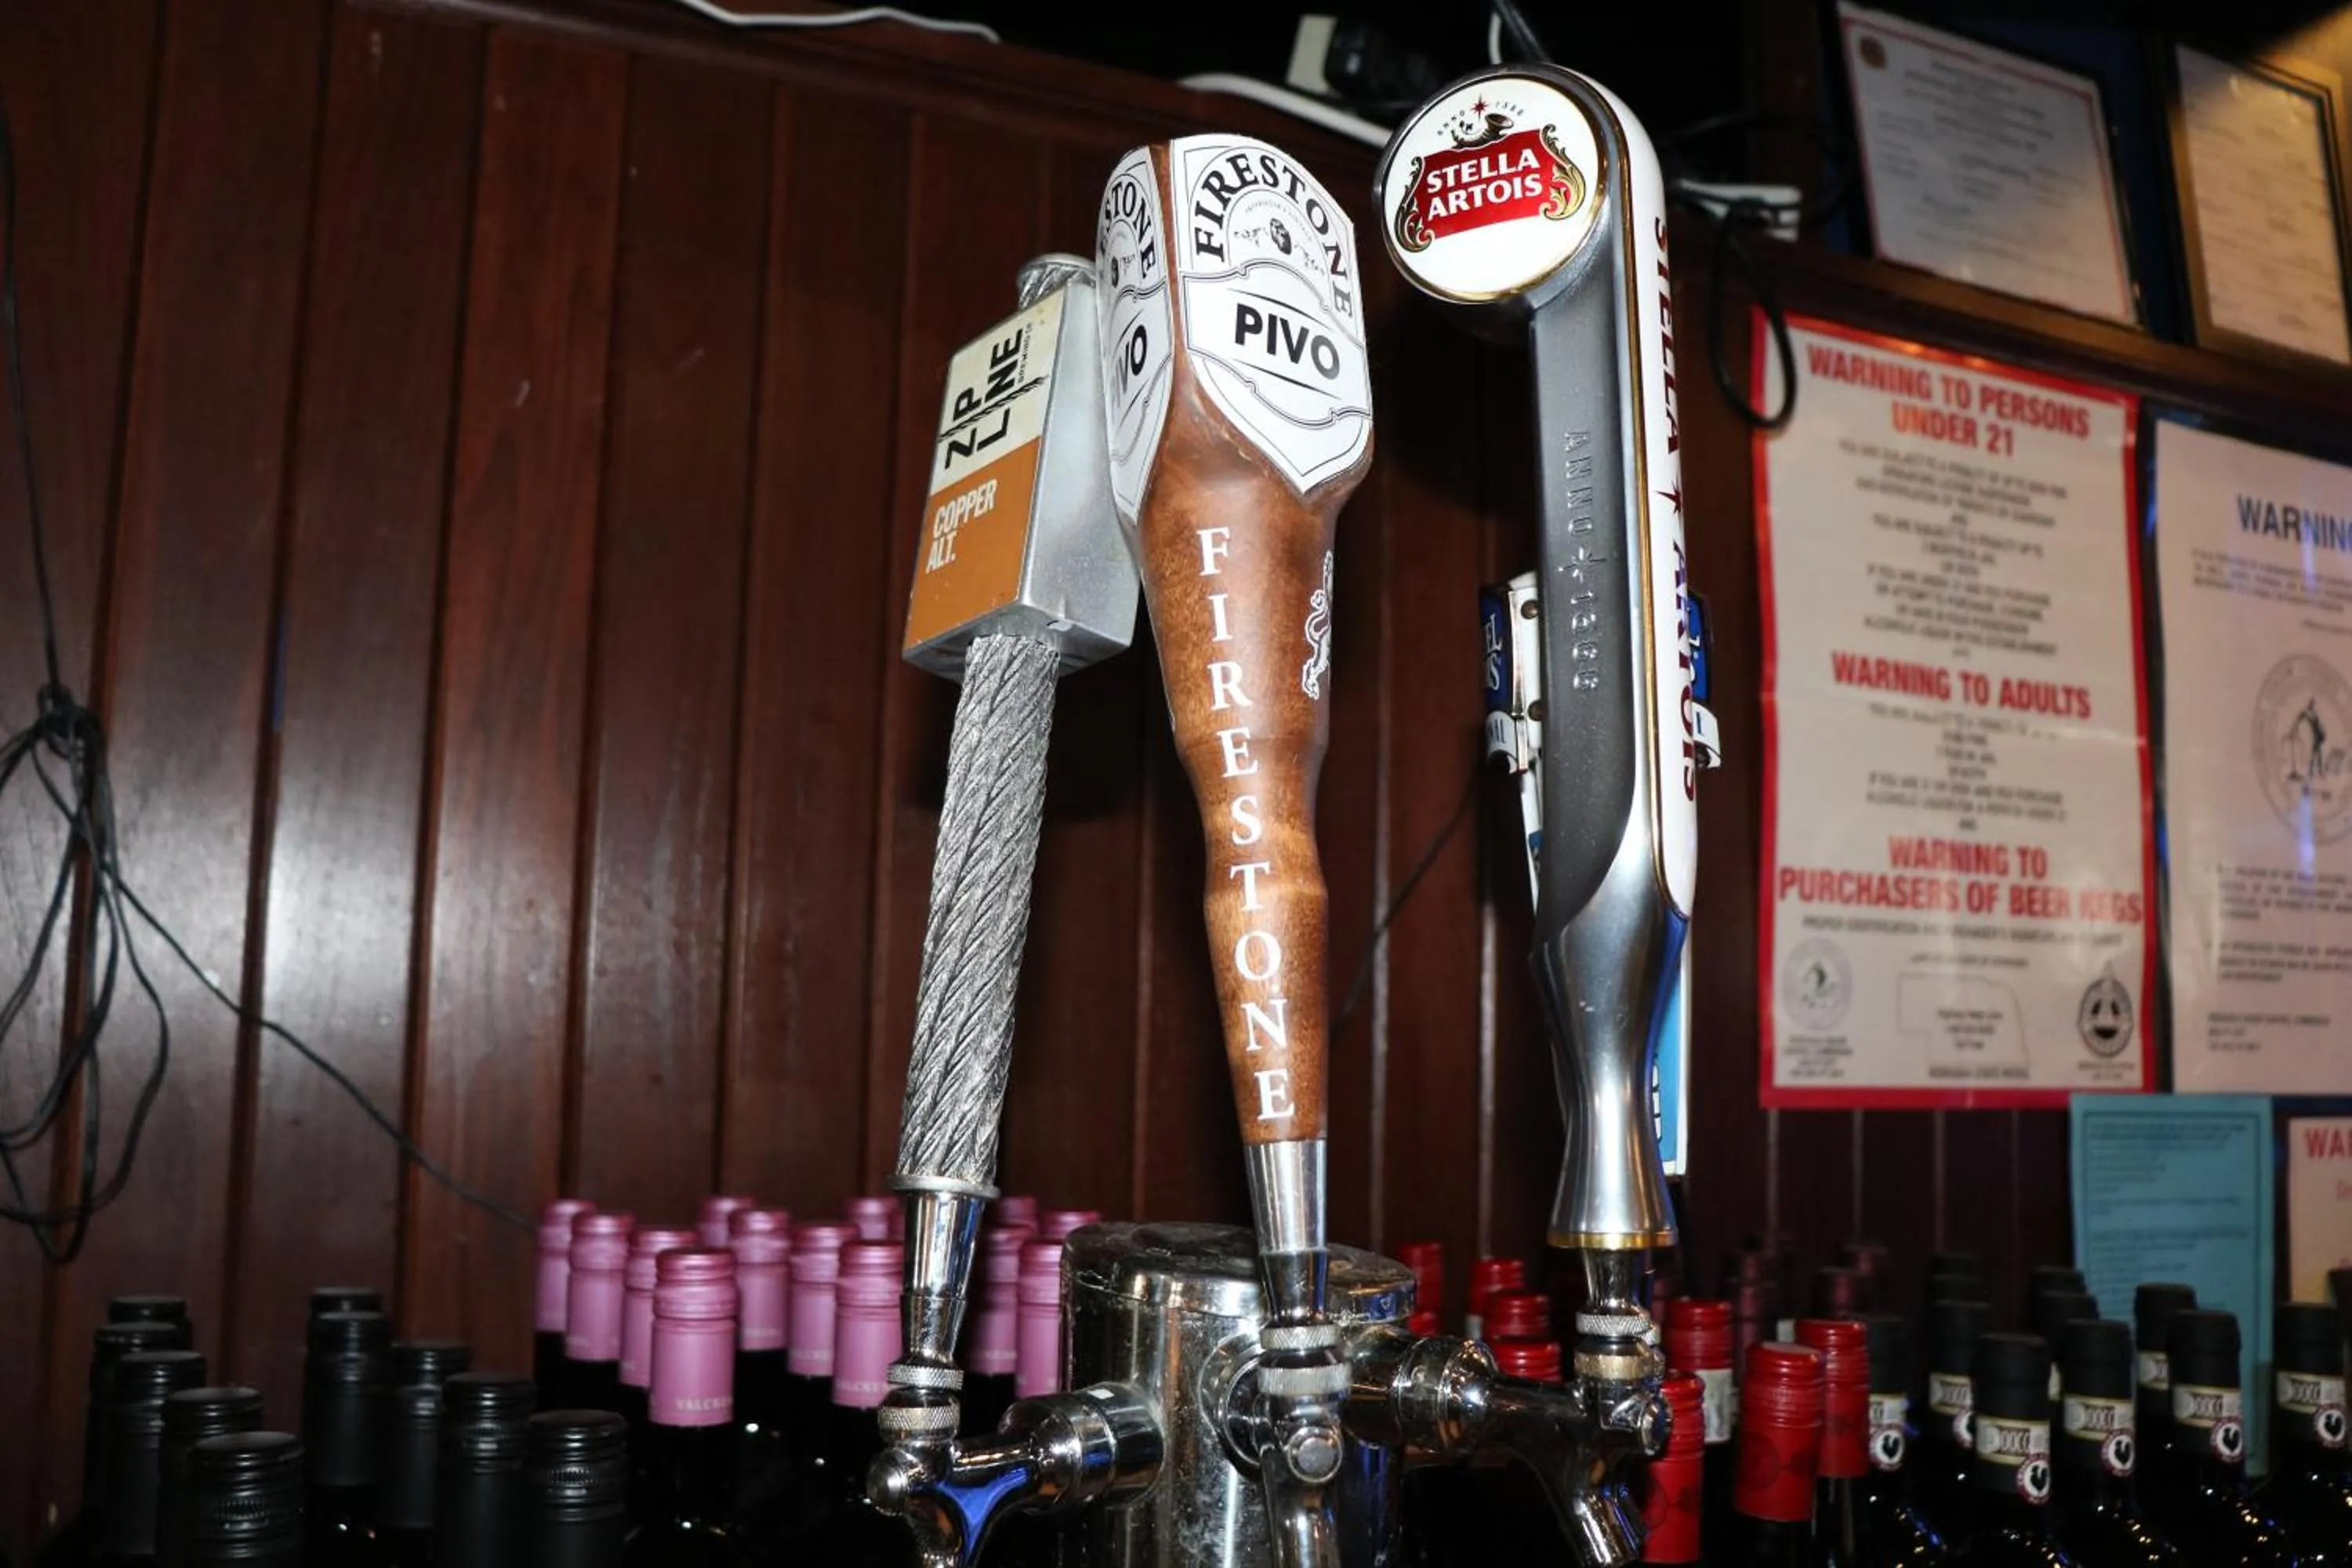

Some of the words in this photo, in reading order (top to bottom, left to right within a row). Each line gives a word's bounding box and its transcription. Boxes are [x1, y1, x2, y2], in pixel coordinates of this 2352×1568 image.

[1427, 148, 1540, 194] STELLA
[1428, 173, 1543, 223] ARTOIS
[1193, 153, 1354, 318] FIRESTONE
[1235, 303, 1341, 379] PIVO
[1806, 343, 1932, 401] WARNING
[1940, 375, 1971, 409] TO
[1980, 384, 2090, 439] PERSONS
[1891, 401, 1978, 448] UNDER
[1986, 423, 2014, 456] 21
[933, 478, 998, 539] COPPER
[1565, 431, 1592, 536] ANNO
[925, 529, 957, 574] ALT.
[1831, 650, 1951, 702] WARNING
[1958, 670, 1991, 706] TO
[1998, 677, 2092, 719] ADULTS
[1196, 526, 1295, 1121] FIRESTONE
[1888, 836, 2009, 877] WARNING
[2016, 847, 2049, 880] TO
[1778, 866, 1959, 912] PURCHASERS
[1966, 881, 1998, 915] OF
[2009, 886, 2071, 920] BEER
[2080, 889, 2143, 923] KEGS
